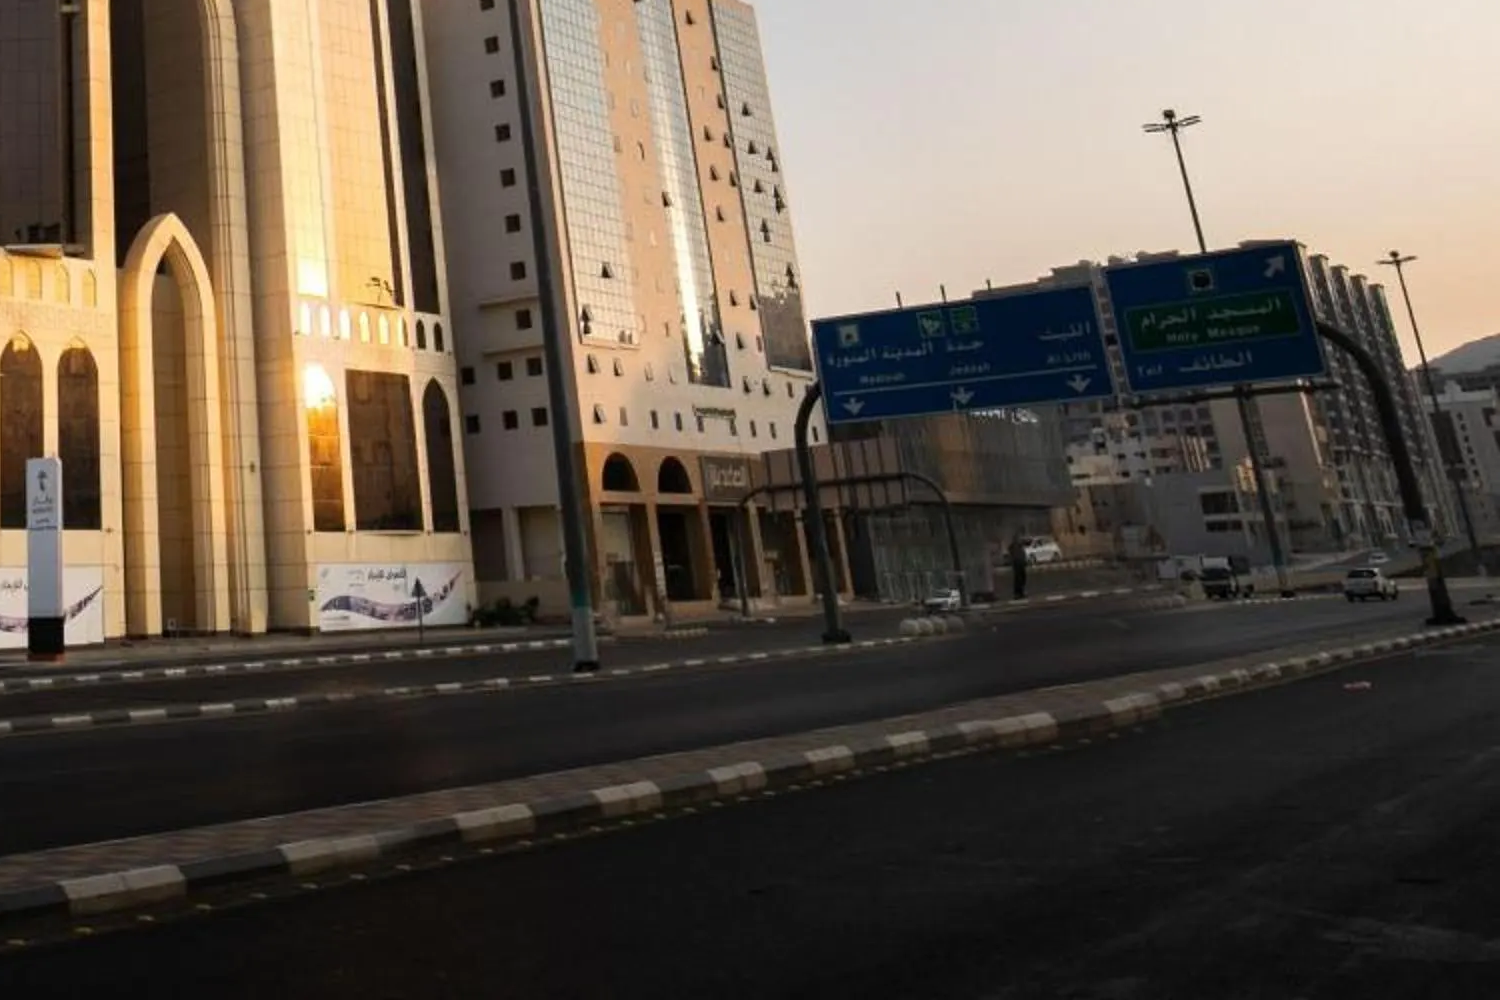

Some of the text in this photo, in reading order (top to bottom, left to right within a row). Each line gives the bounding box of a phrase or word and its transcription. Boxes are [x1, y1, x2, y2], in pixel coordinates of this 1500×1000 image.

[1140, 296, 1282, 332] المسجد الحرام
[946, 337, 985, 353] جدة
[1178, 349, 1253, 373] الطائف
